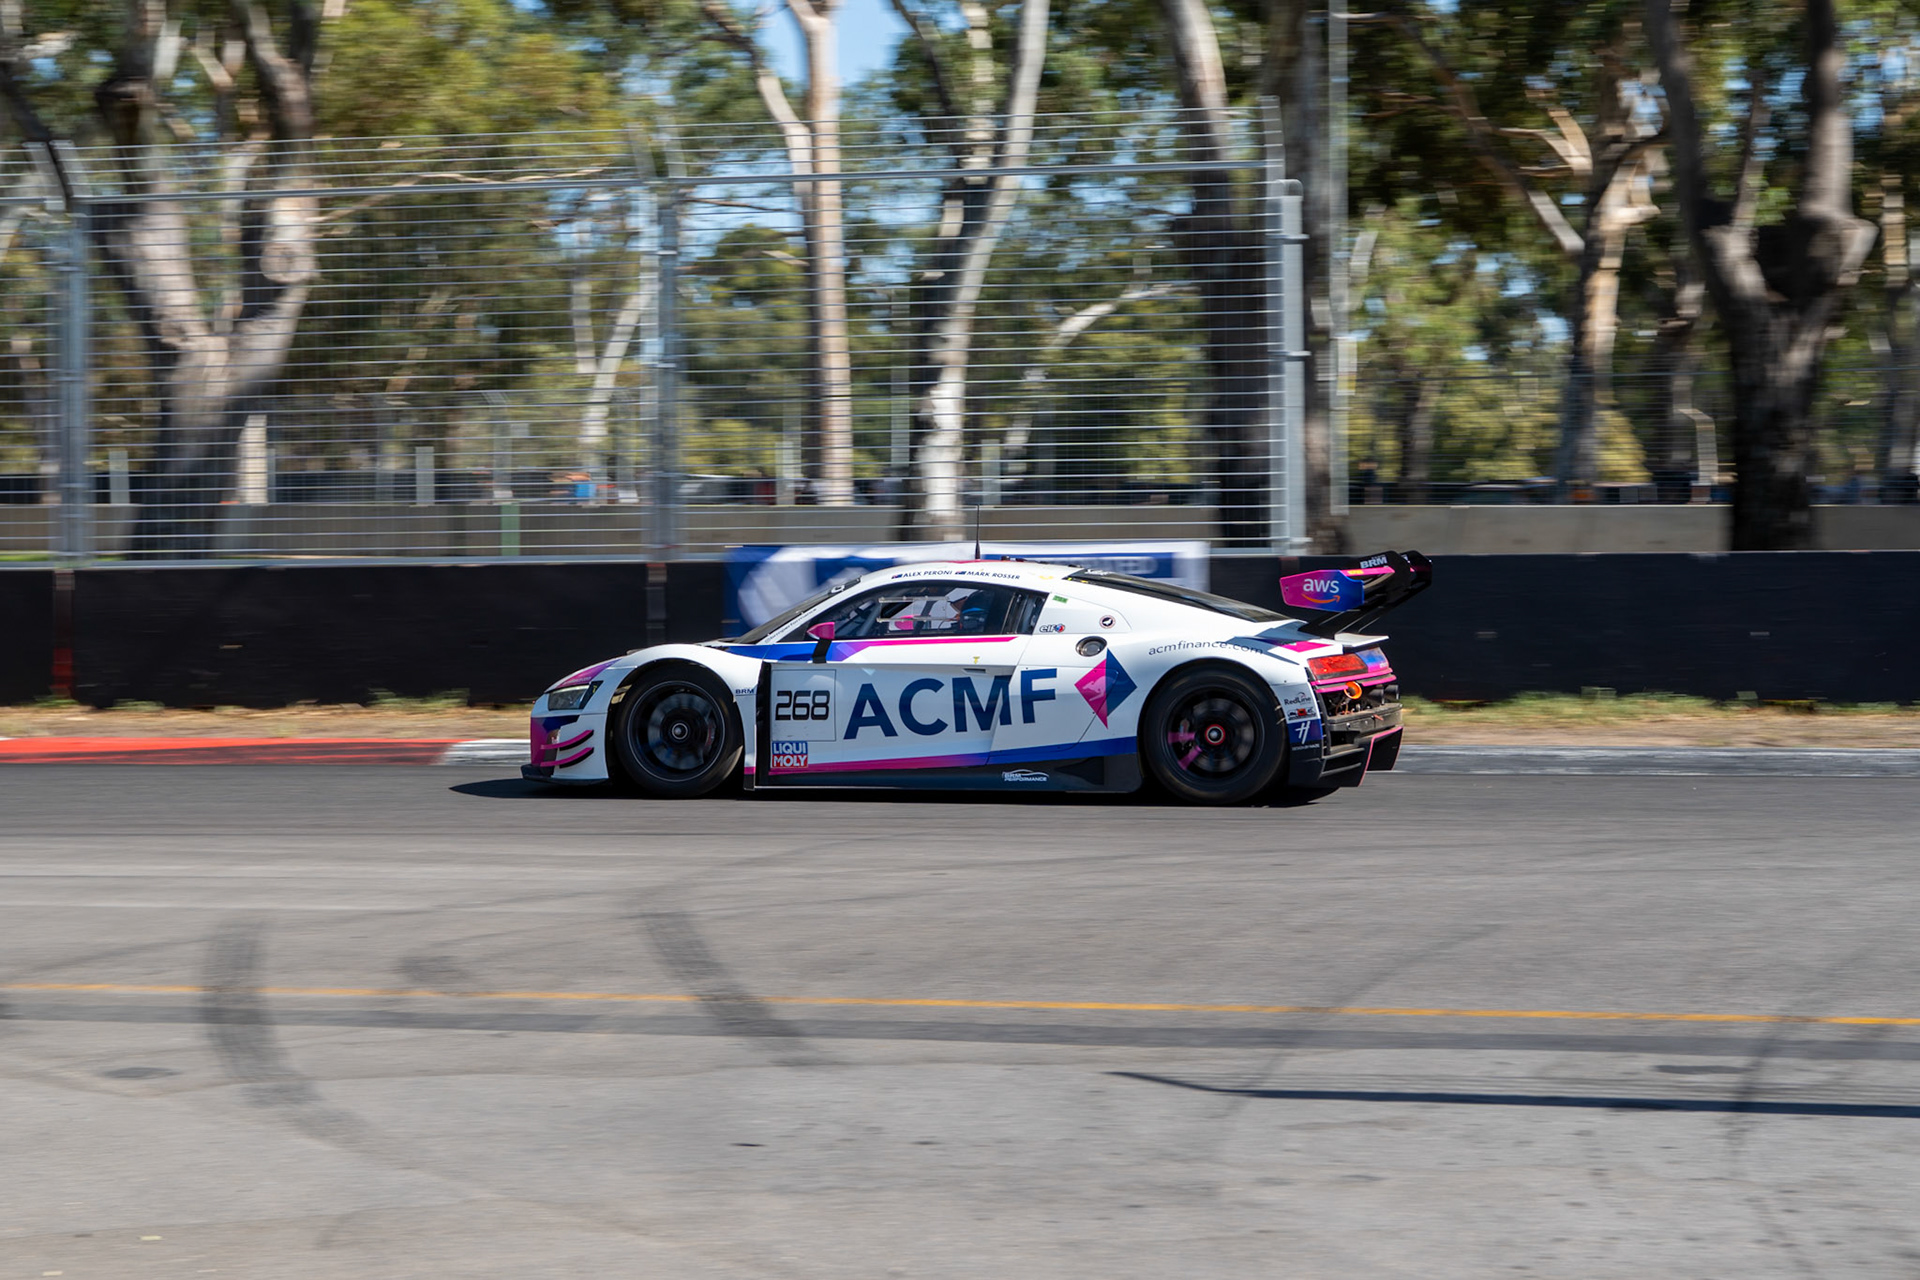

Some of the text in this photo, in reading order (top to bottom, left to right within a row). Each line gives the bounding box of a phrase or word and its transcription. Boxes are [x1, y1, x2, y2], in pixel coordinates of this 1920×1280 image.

[1360, 556, 1388, 569] BRM
[991, 572, 1021, 580] ROSSER
[1303, 578, 1340, 594] aws
[1039, 624, 1056, 633] elf
[1148, 640, 1264, 656] acmfinance.com
[775, 690, 830, 720] 268
[843, 668, 1058, 740] ACMF
[773, 742, 807, 754] LIQUI
[773, 755, 807, 767] MOLY
